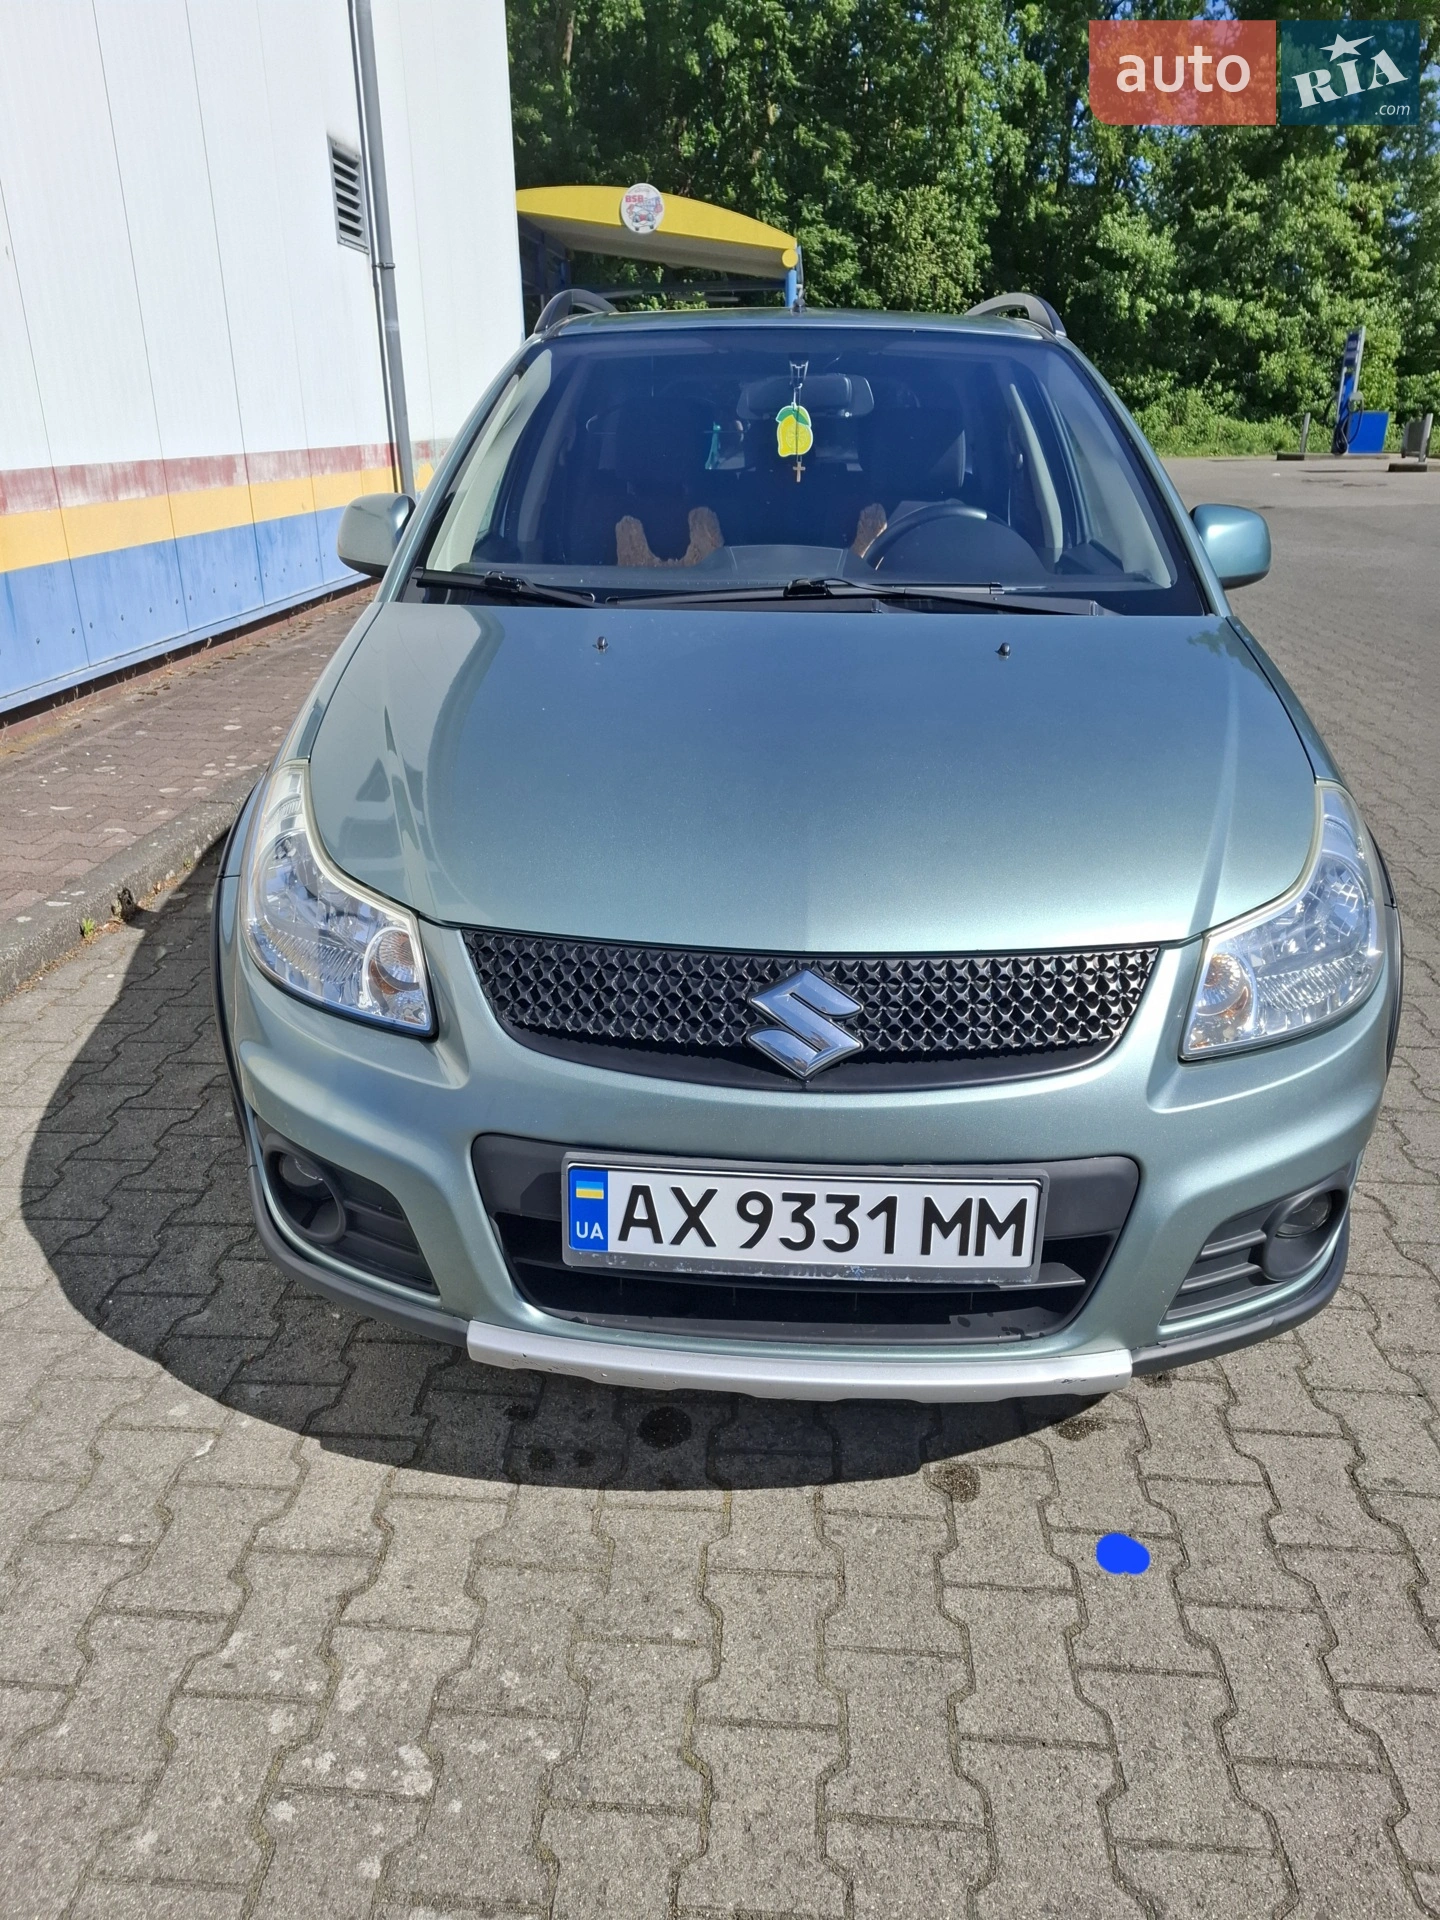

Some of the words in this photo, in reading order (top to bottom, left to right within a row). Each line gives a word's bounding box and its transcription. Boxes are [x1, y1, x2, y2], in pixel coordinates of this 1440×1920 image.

[625, 194, 644, 203] BSB
[617, 1184, 718, 1248] AX
[736, 1190, 899, 1255] 9331
[921, 1196, 1028, 1257] MM
[575, 1221, 604, 1240] UA
